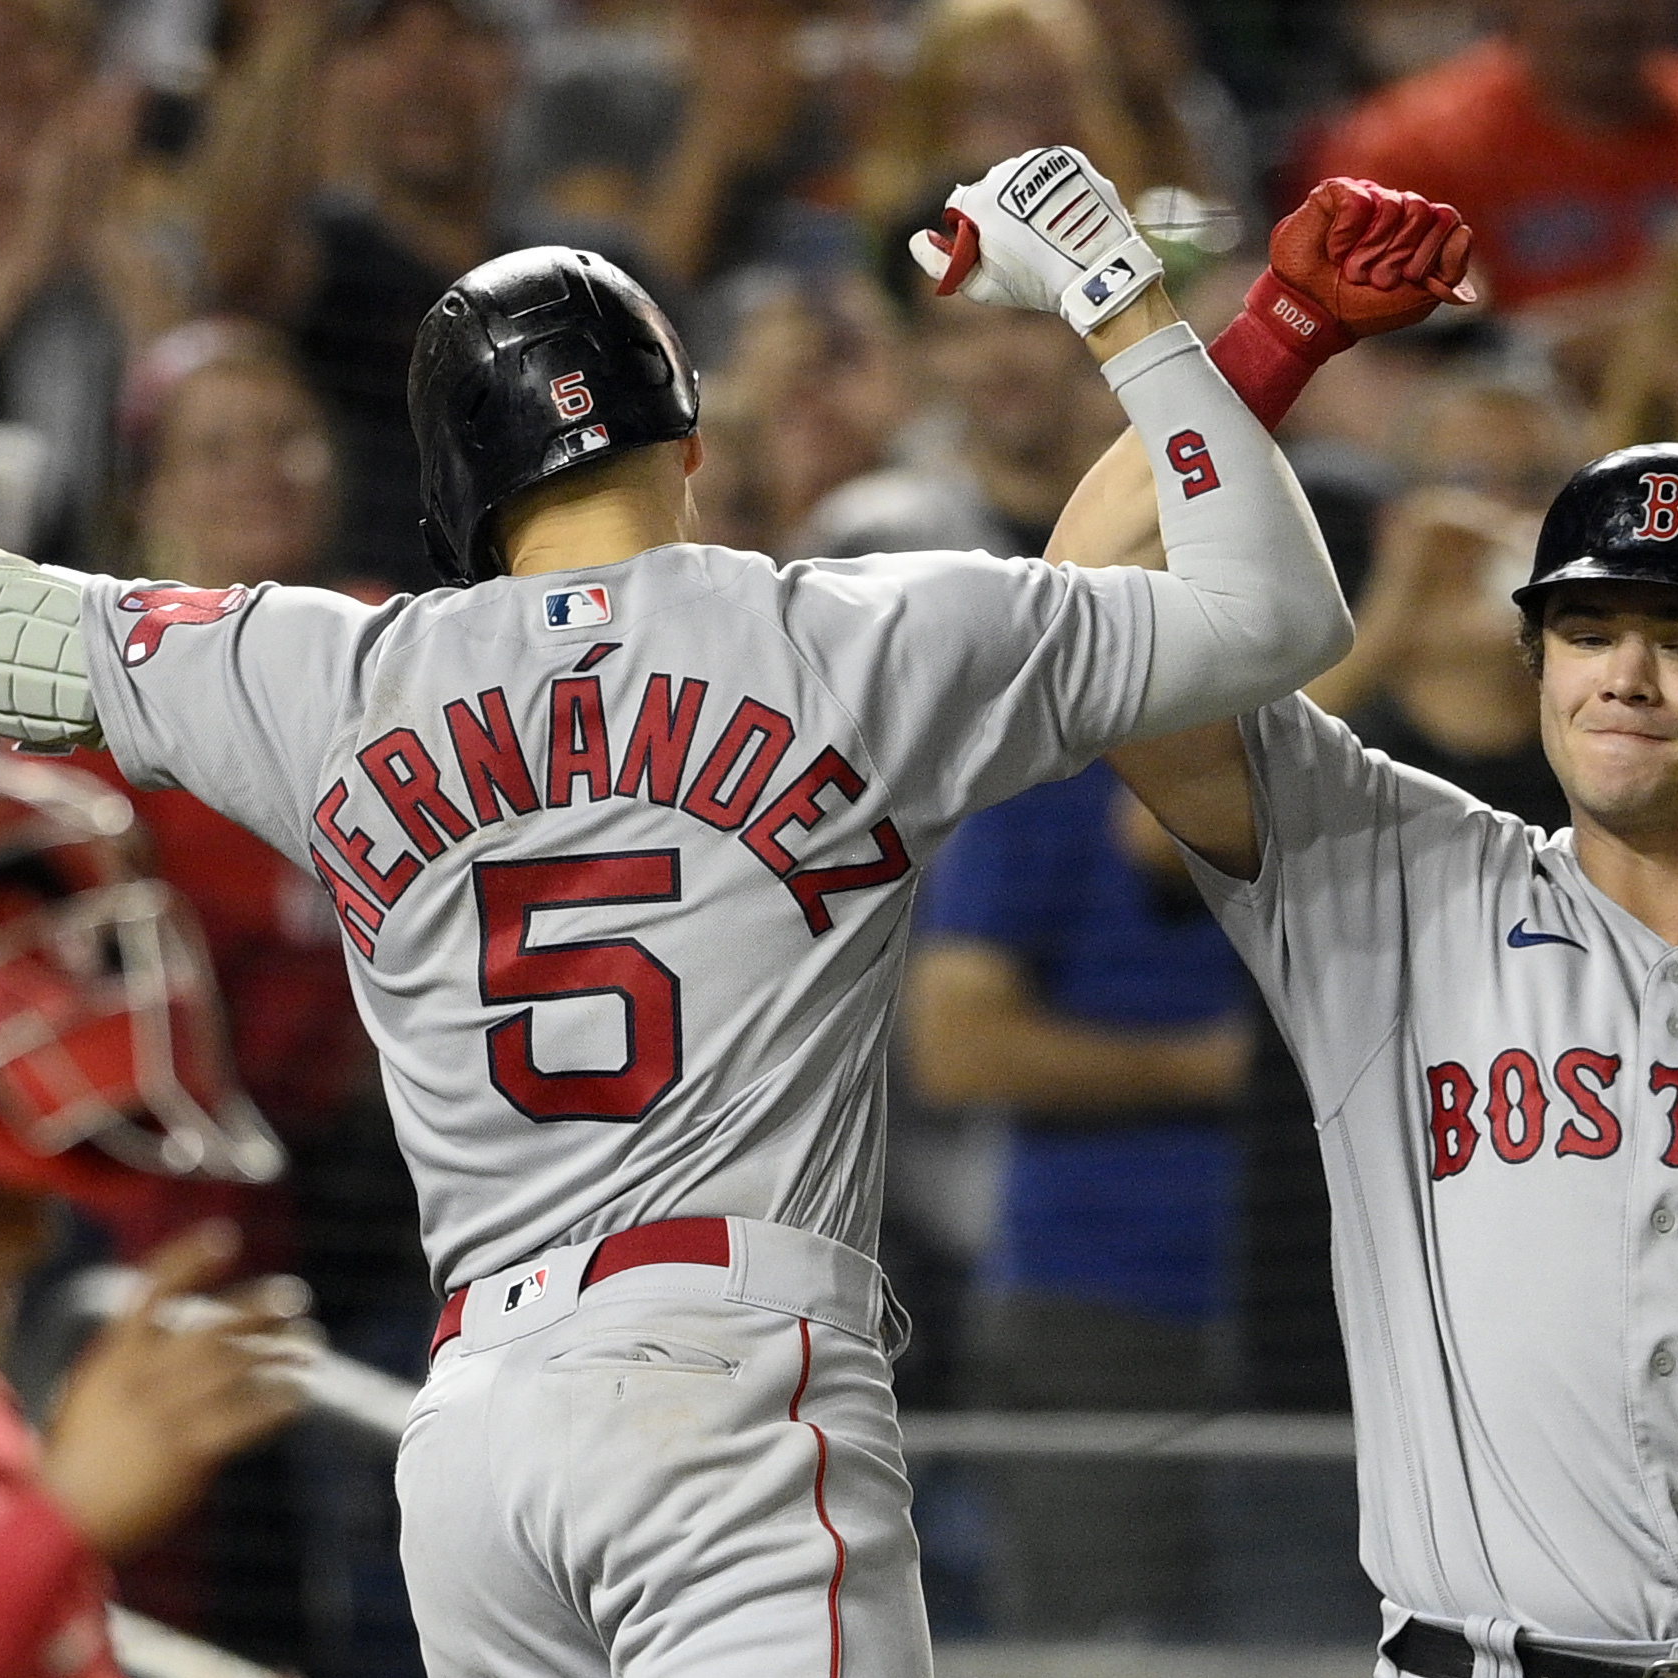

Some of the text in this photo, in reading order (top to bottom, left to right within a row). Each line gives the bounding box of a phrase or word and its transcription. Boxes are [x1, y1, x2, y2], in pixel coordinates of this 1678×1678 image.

[1009, 152, 1070, 216] Franklin
[1272, 297, 1317, 337] BD29
[549, 369, 594, 420] 5
[308, 642, 912, 965] HERNÁNDEZ
[471, 847, 683, 1124] 5
